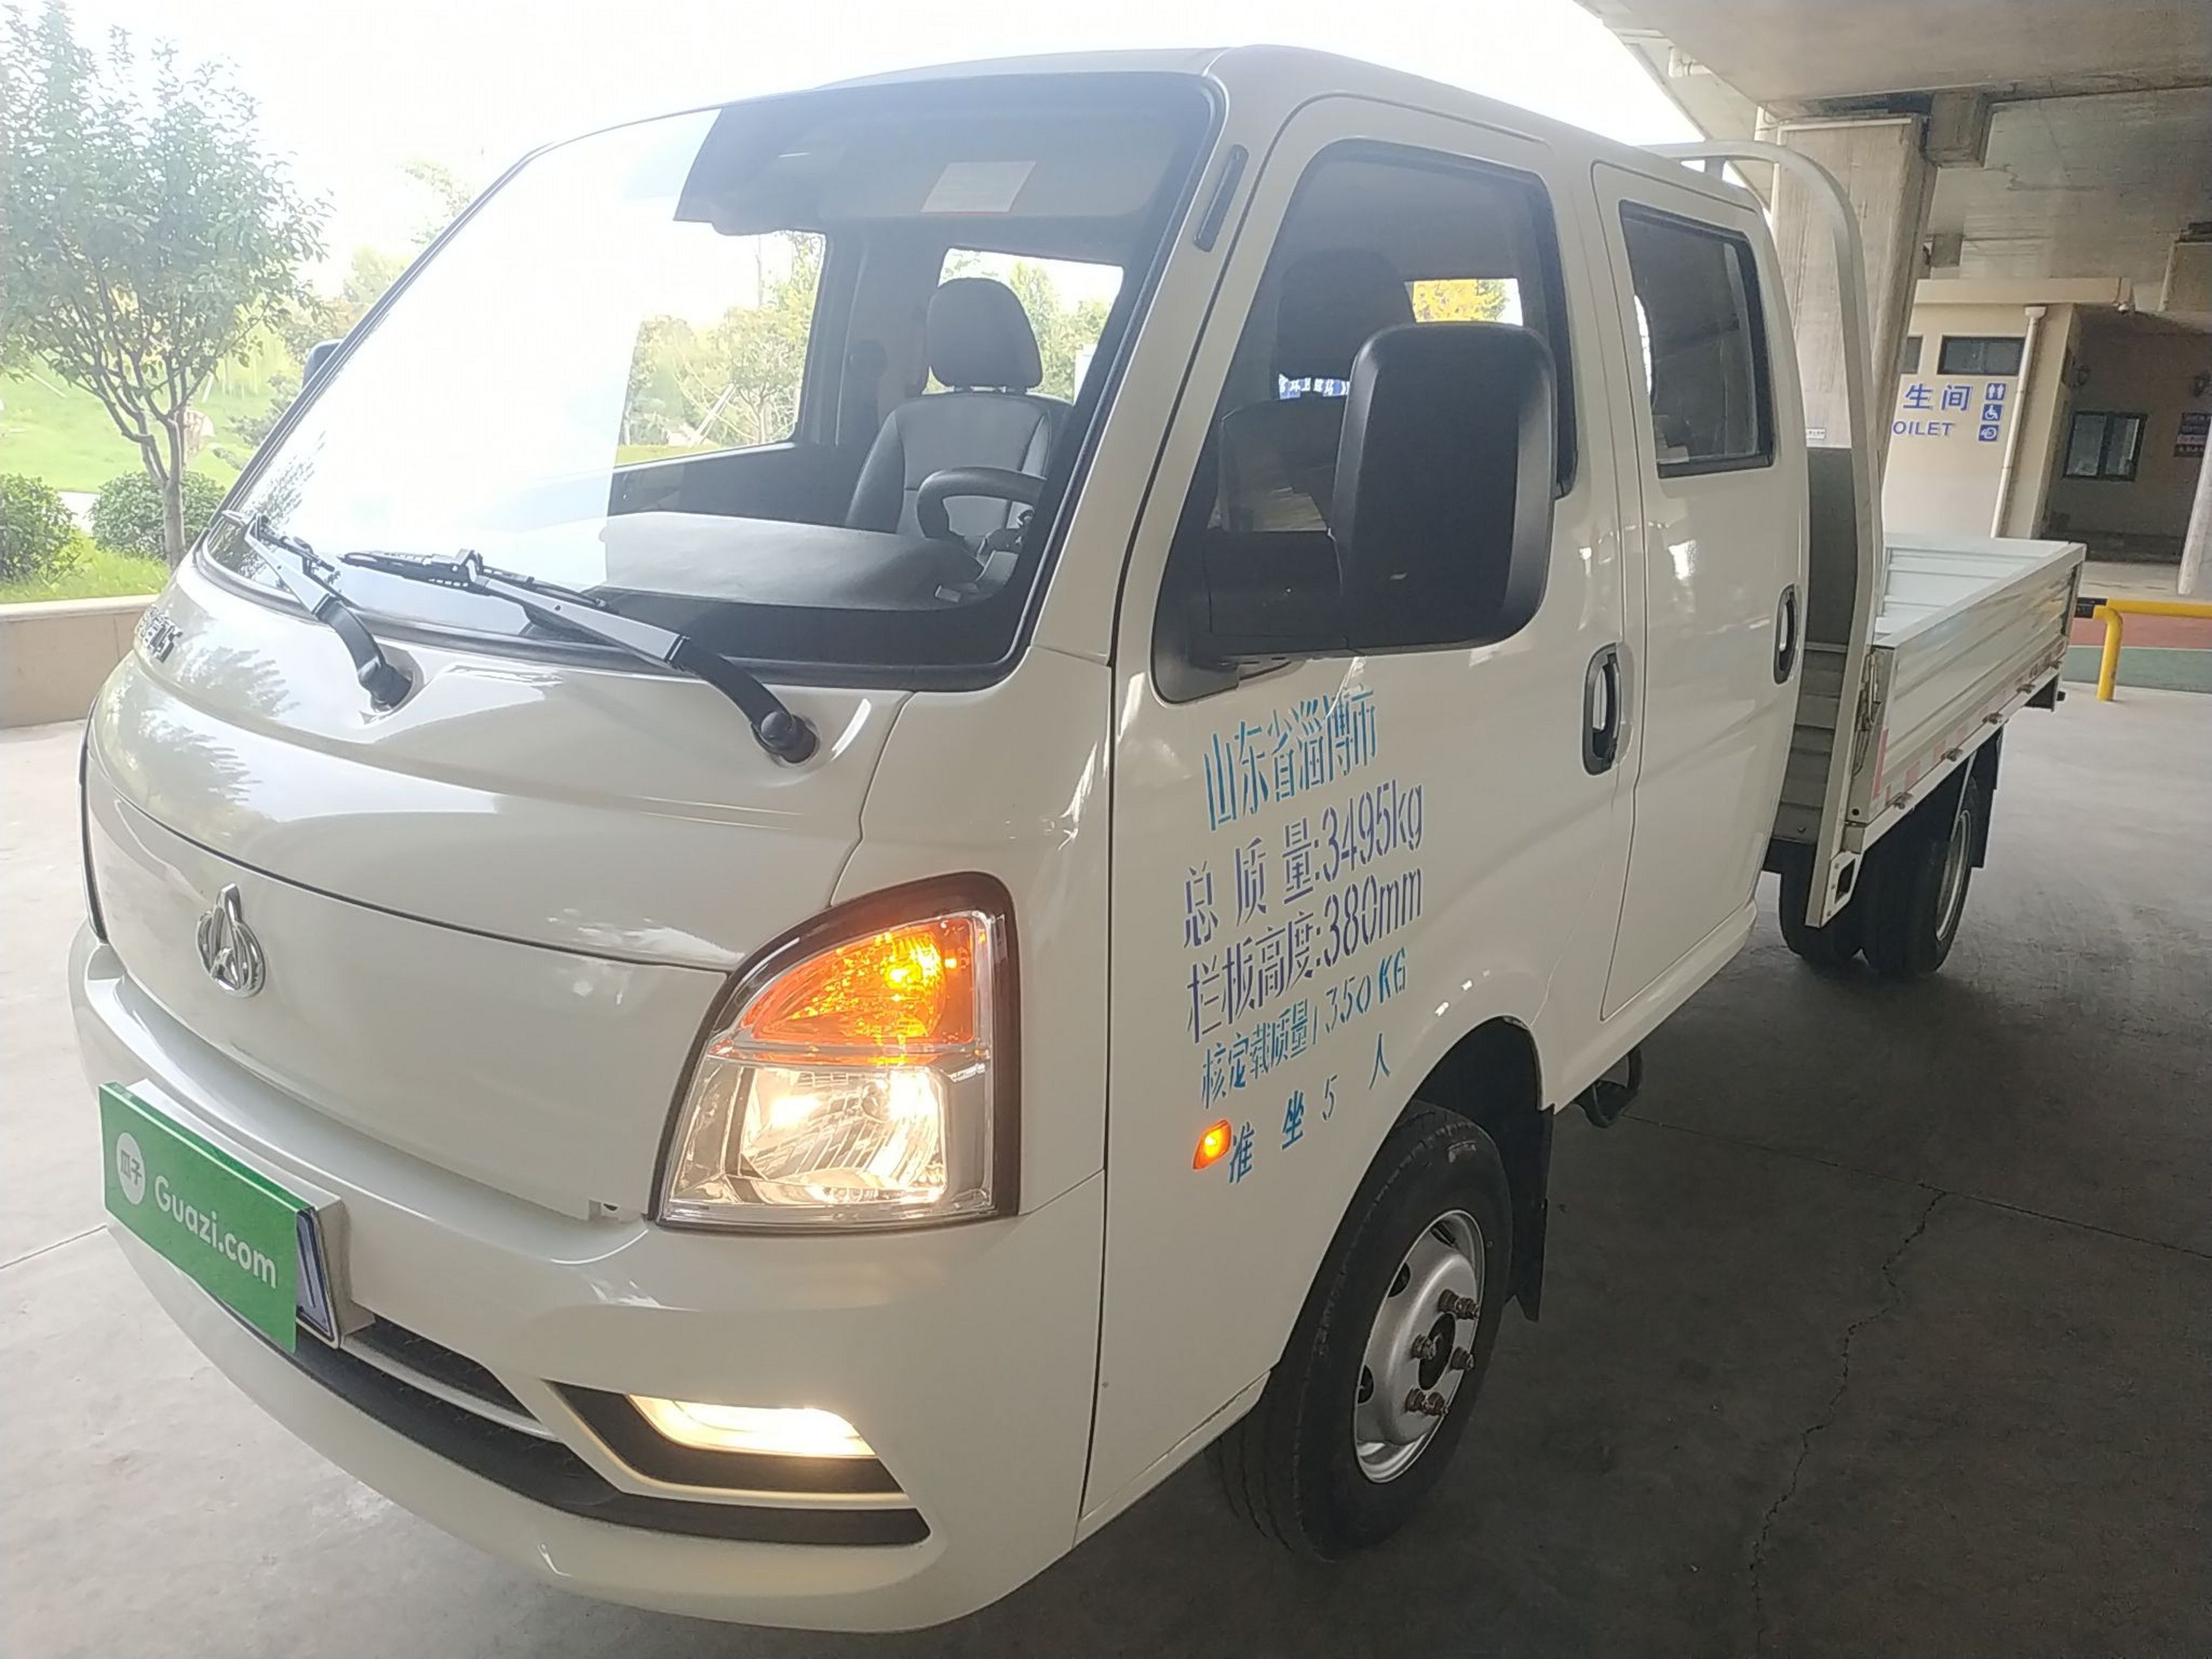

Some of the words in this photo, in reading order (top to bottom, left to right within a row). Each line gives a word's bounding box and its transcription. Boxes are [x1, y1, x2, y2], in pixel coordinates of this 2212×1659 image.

[1903, 383, 1972, 411] 生间
[1893, 421, 1954, 435] OILET
[154, 1175, 276, 1289] Guazi.com
